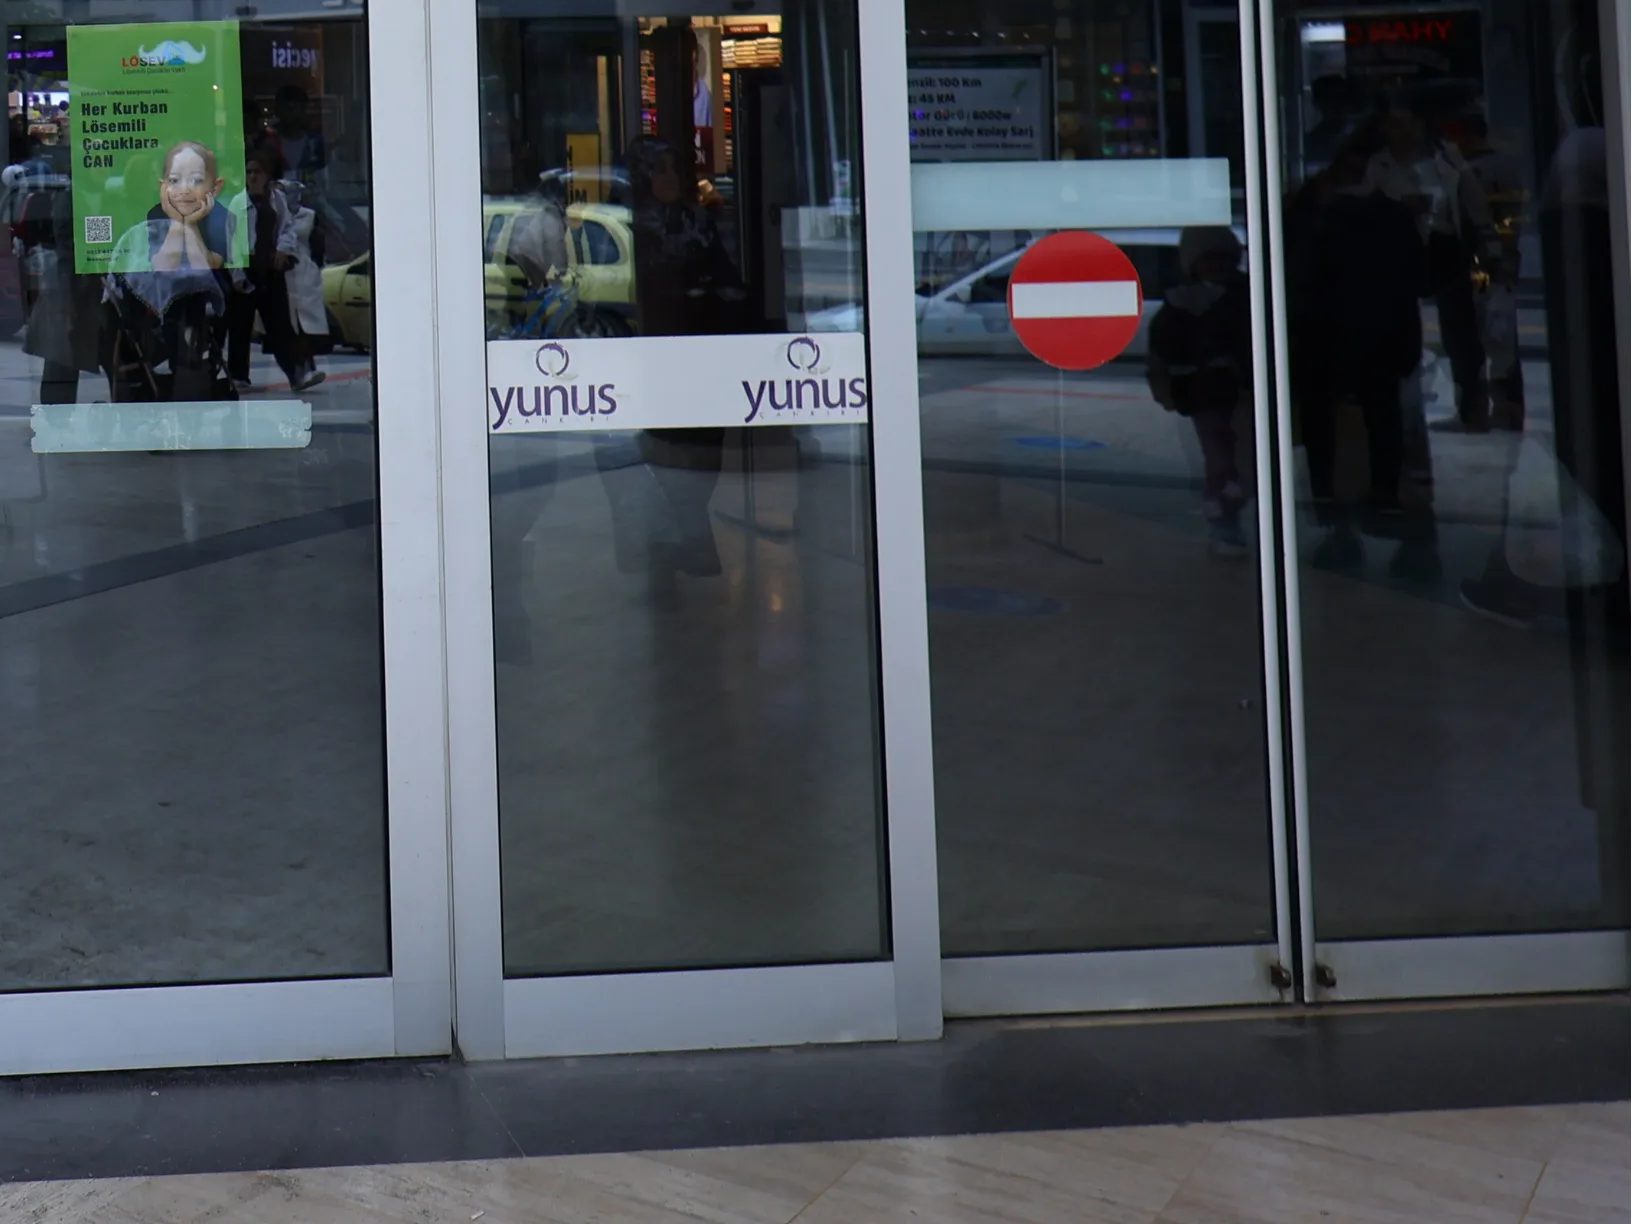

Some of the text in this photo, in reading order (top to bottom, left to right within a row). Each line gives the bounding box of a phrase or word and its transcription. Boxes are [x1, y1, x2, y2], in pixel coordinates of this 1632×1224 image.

[122, 55, 165, 67] LÖSEV
[81, 100, 168, 116] Her Kurban
[81, 117, 146, 134] Lösemili
[82, 136, 159, 155] Çocuklara
[83, 153, 114, 169] CAN
[489, 383, 617, 430] yunus
[742, 377, 867, 424] yunus
